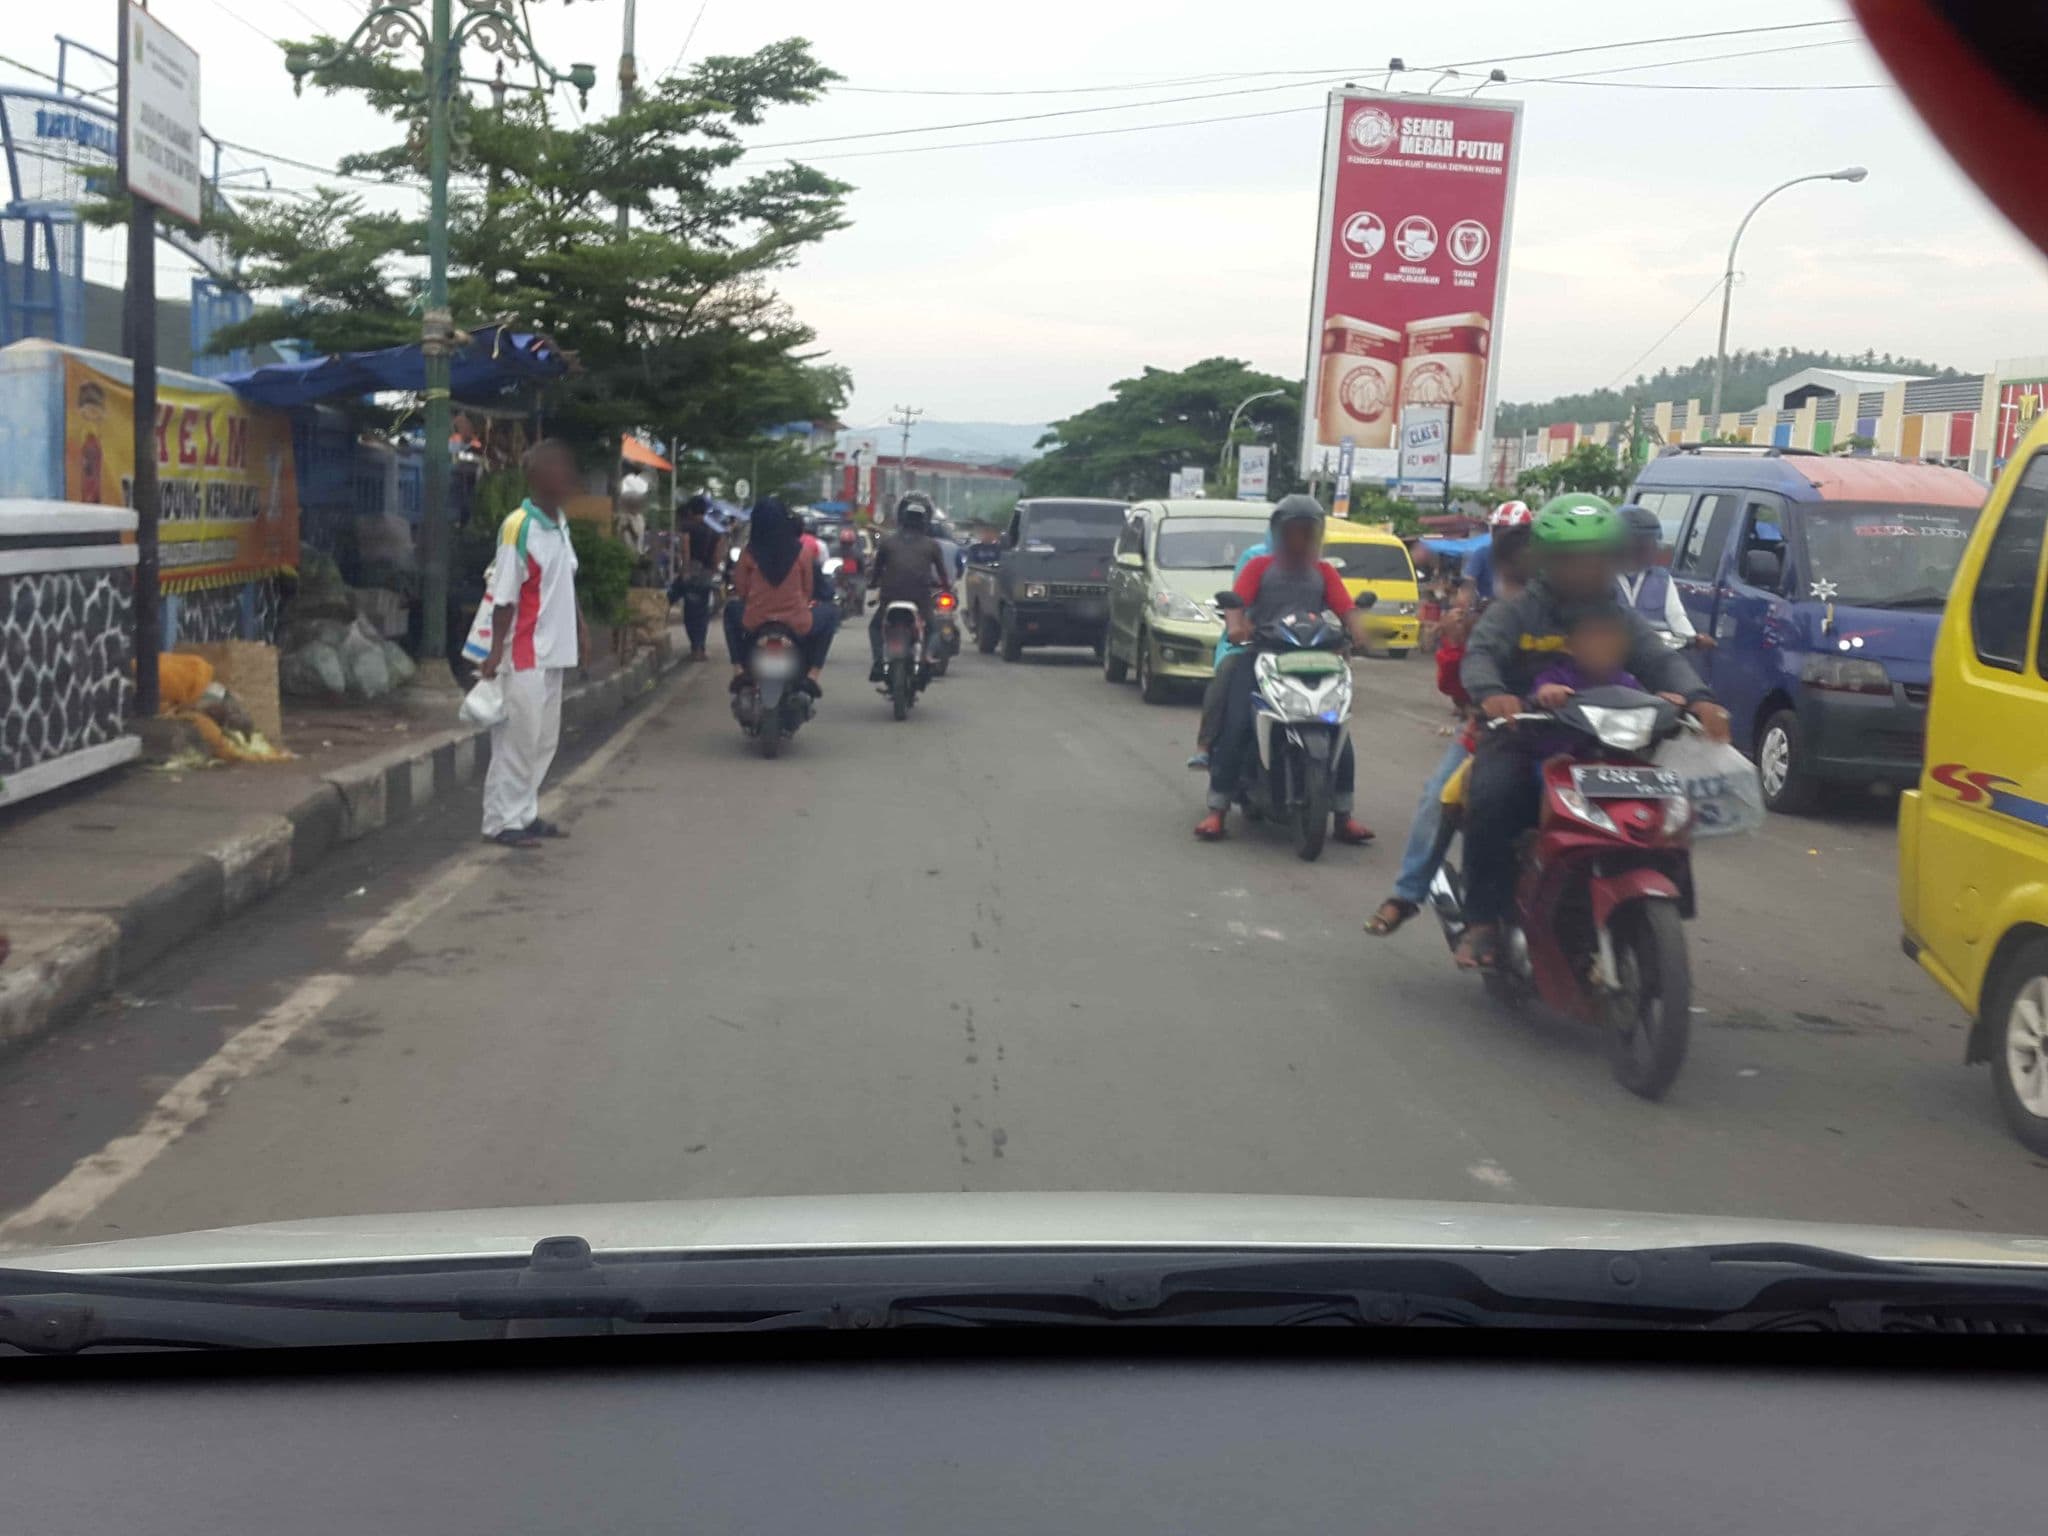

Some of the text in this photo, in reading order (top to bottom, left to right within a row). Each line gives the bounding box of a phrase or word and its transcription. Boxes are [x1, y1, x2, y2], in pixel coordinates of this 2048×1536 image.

[1401, 117, 1454, 138] SEMEN
[1400, 135, 1504, 161] MERAH PUTIH
